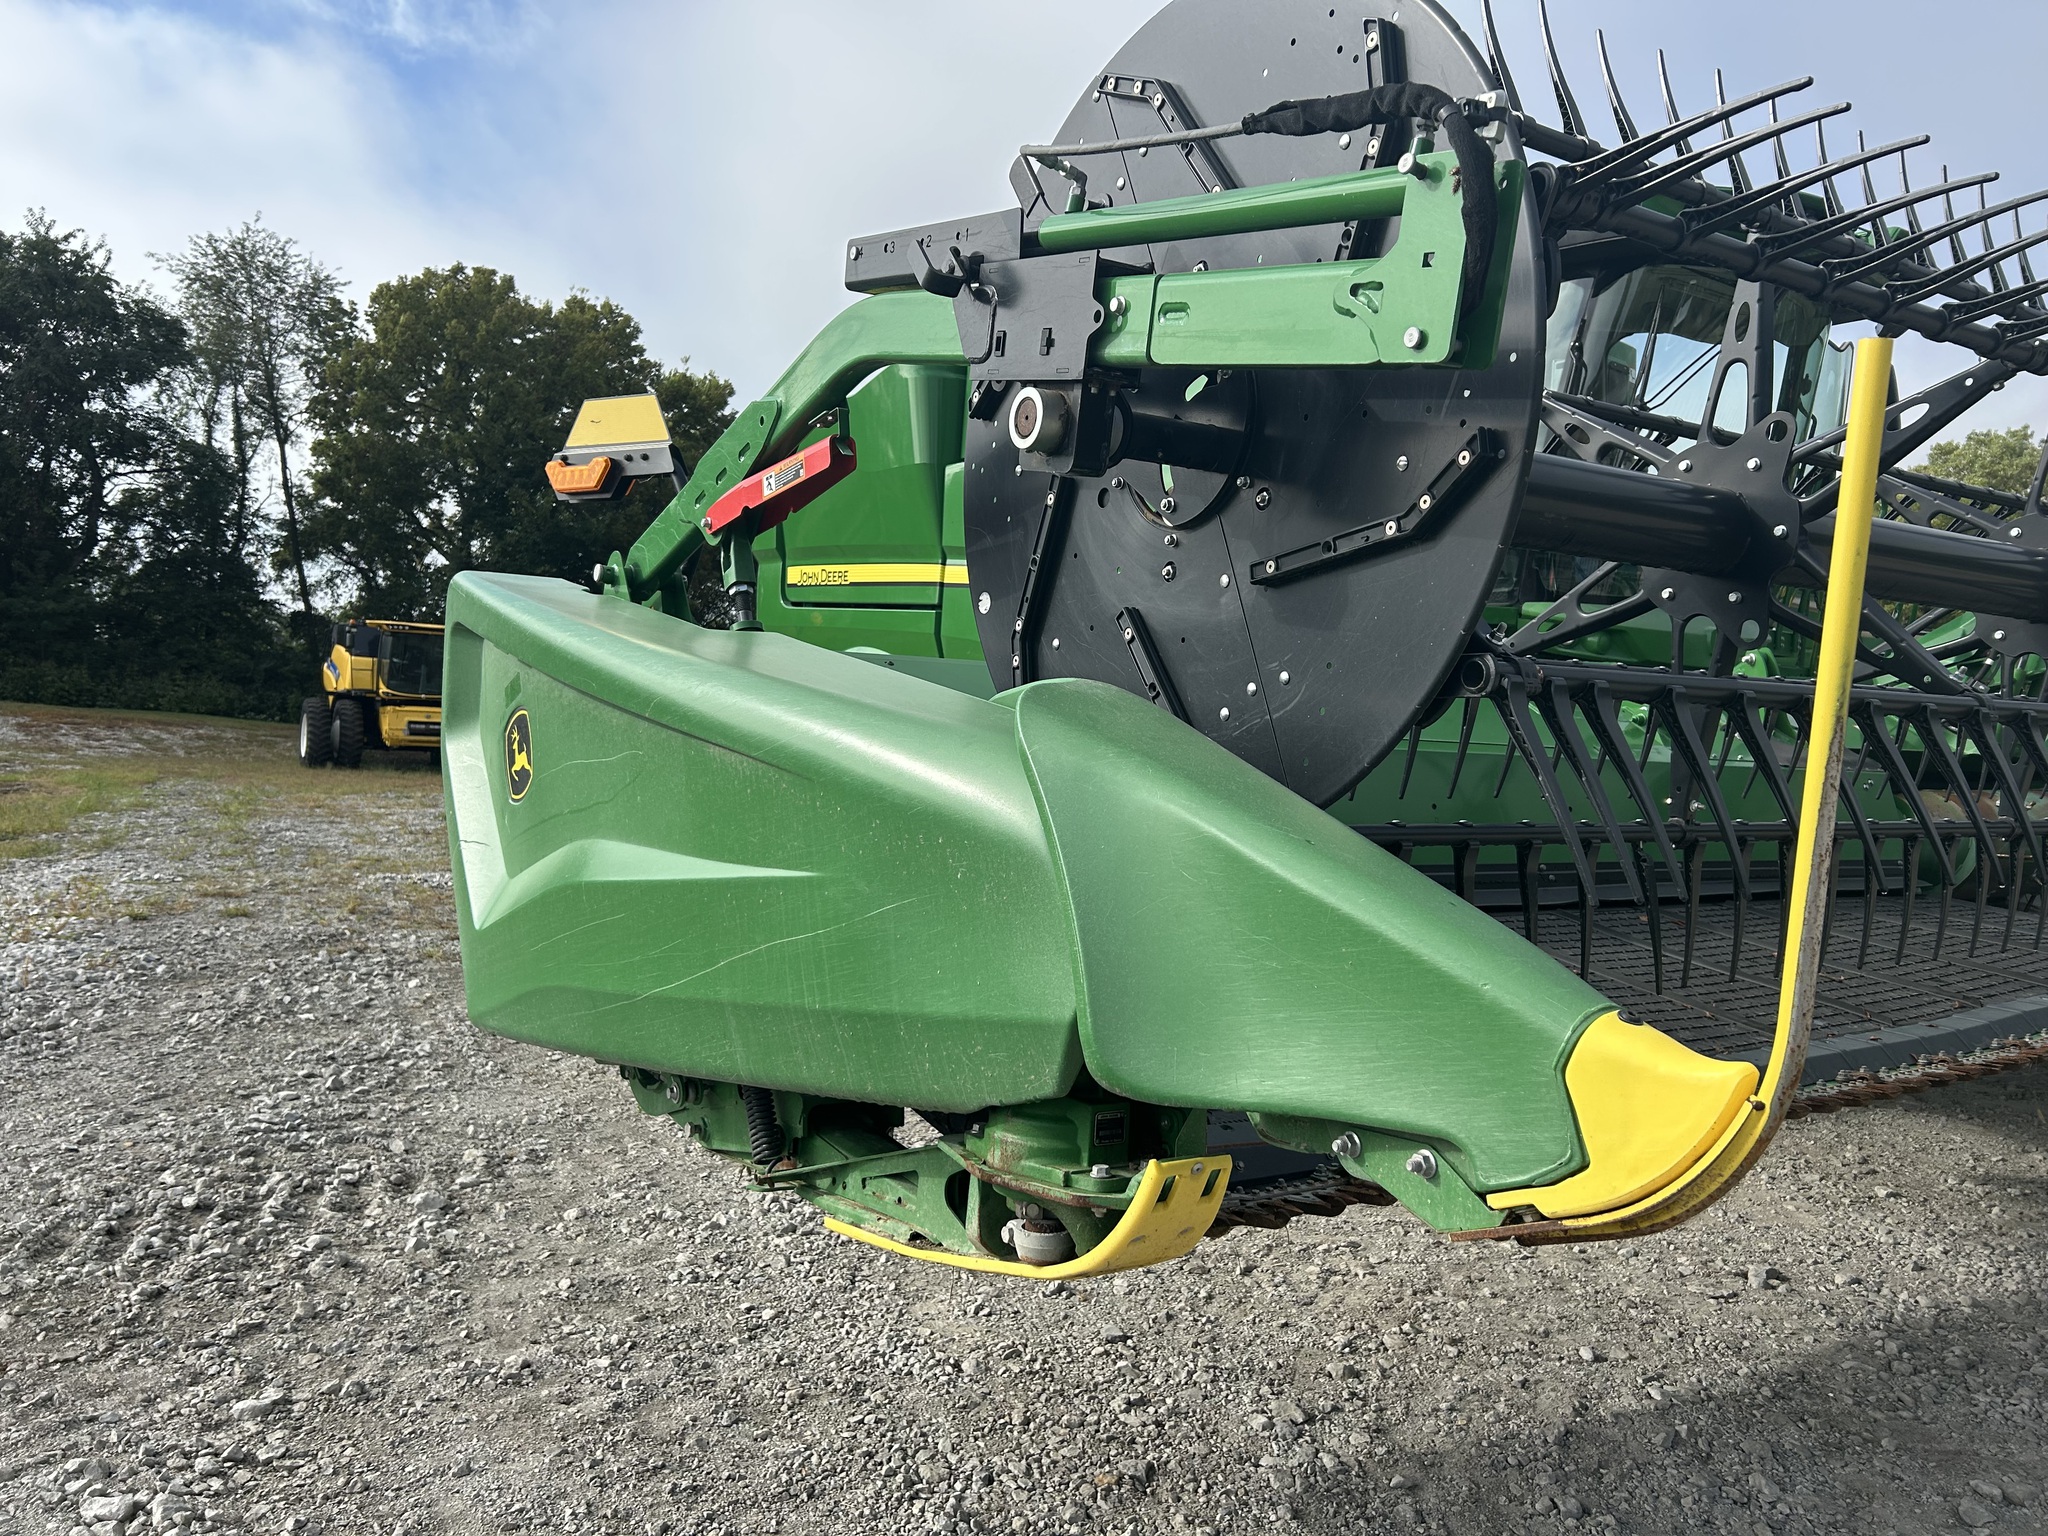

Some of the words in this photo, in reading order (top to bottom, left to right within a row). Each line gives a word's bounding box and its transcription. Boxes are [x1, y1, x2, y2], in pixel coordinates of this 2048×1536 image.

[889, 241, 896, 254] 3
[926, 234, 933, 248] 2
[797, 569, 820, 583] JOHN
[821, 568, 849, 582] DEERE
